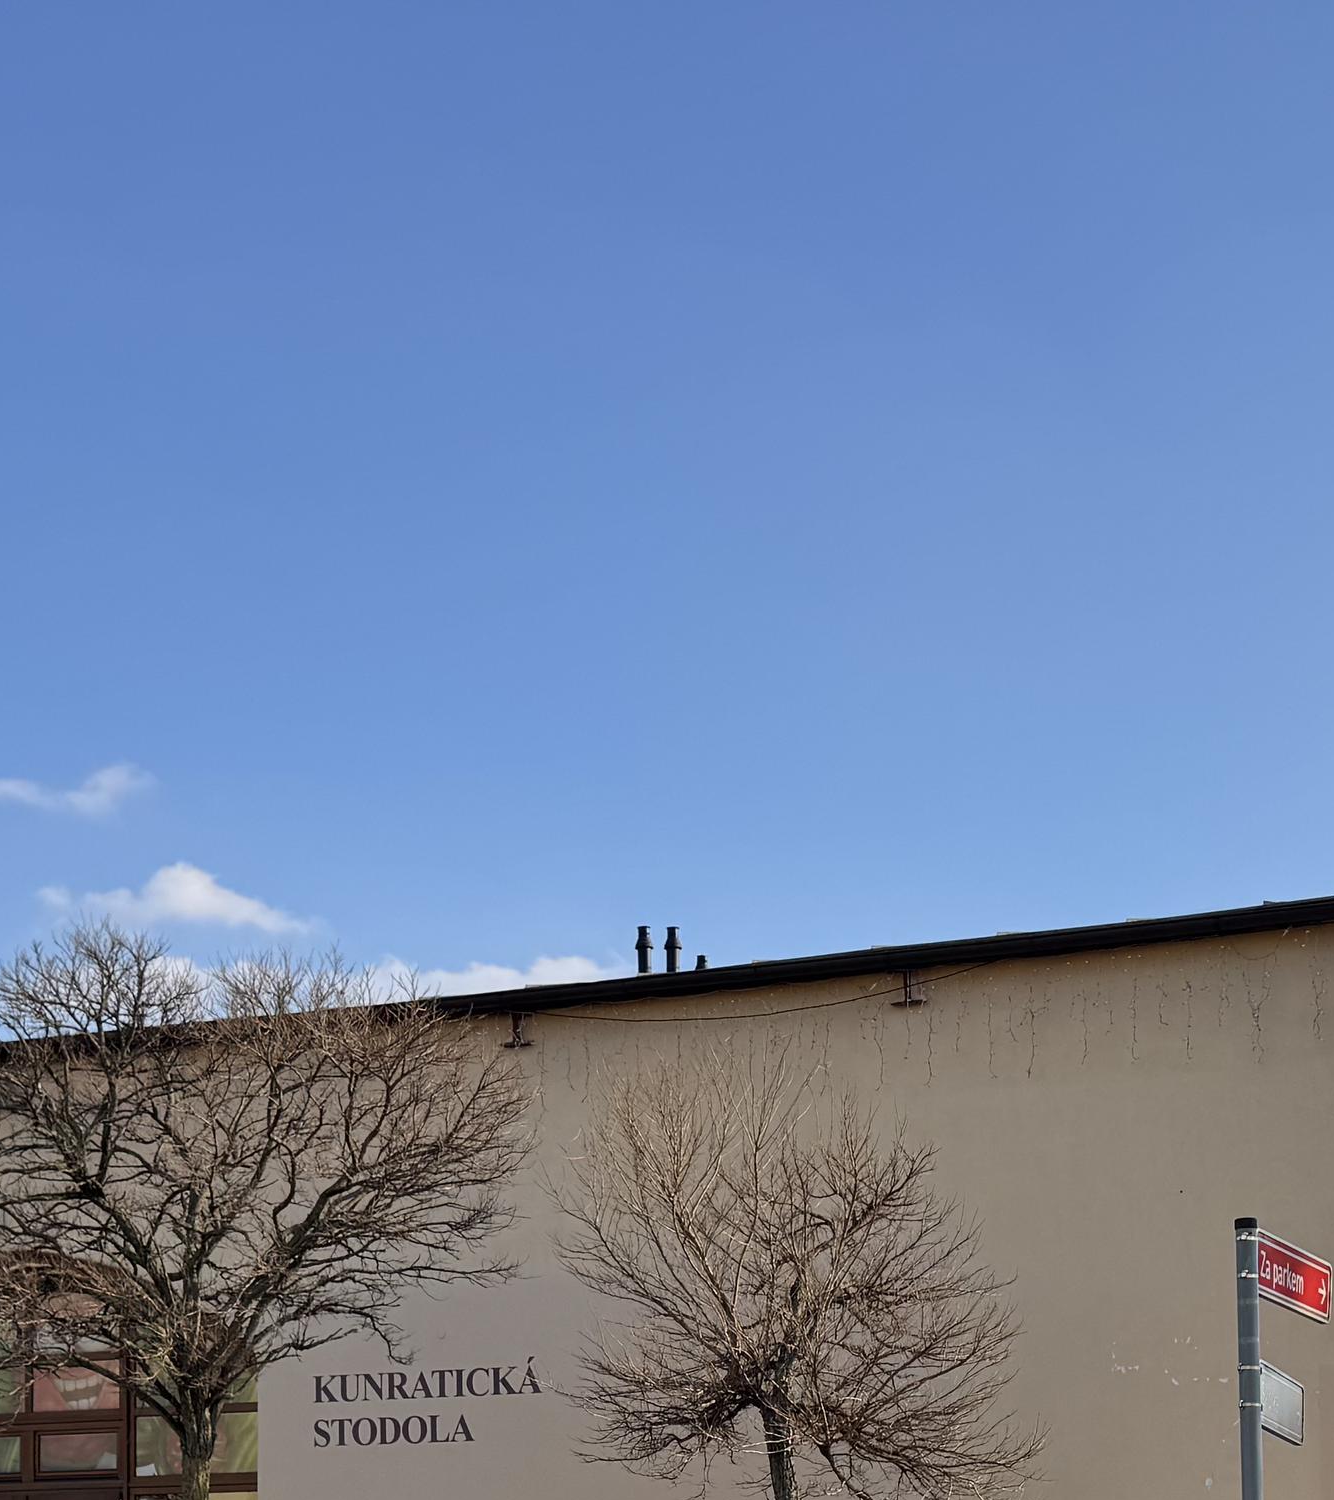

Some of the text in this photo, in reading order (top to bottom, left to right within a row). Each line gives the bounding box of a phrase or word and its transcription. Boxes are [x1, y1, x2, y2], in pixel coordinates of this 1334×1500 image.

[1260, 1250, 1304, 1296] Za parkem
[313, 1356, 542, 1403] KUNRATICKÁ
[313, 1414, 476, 1448] STODOLA
